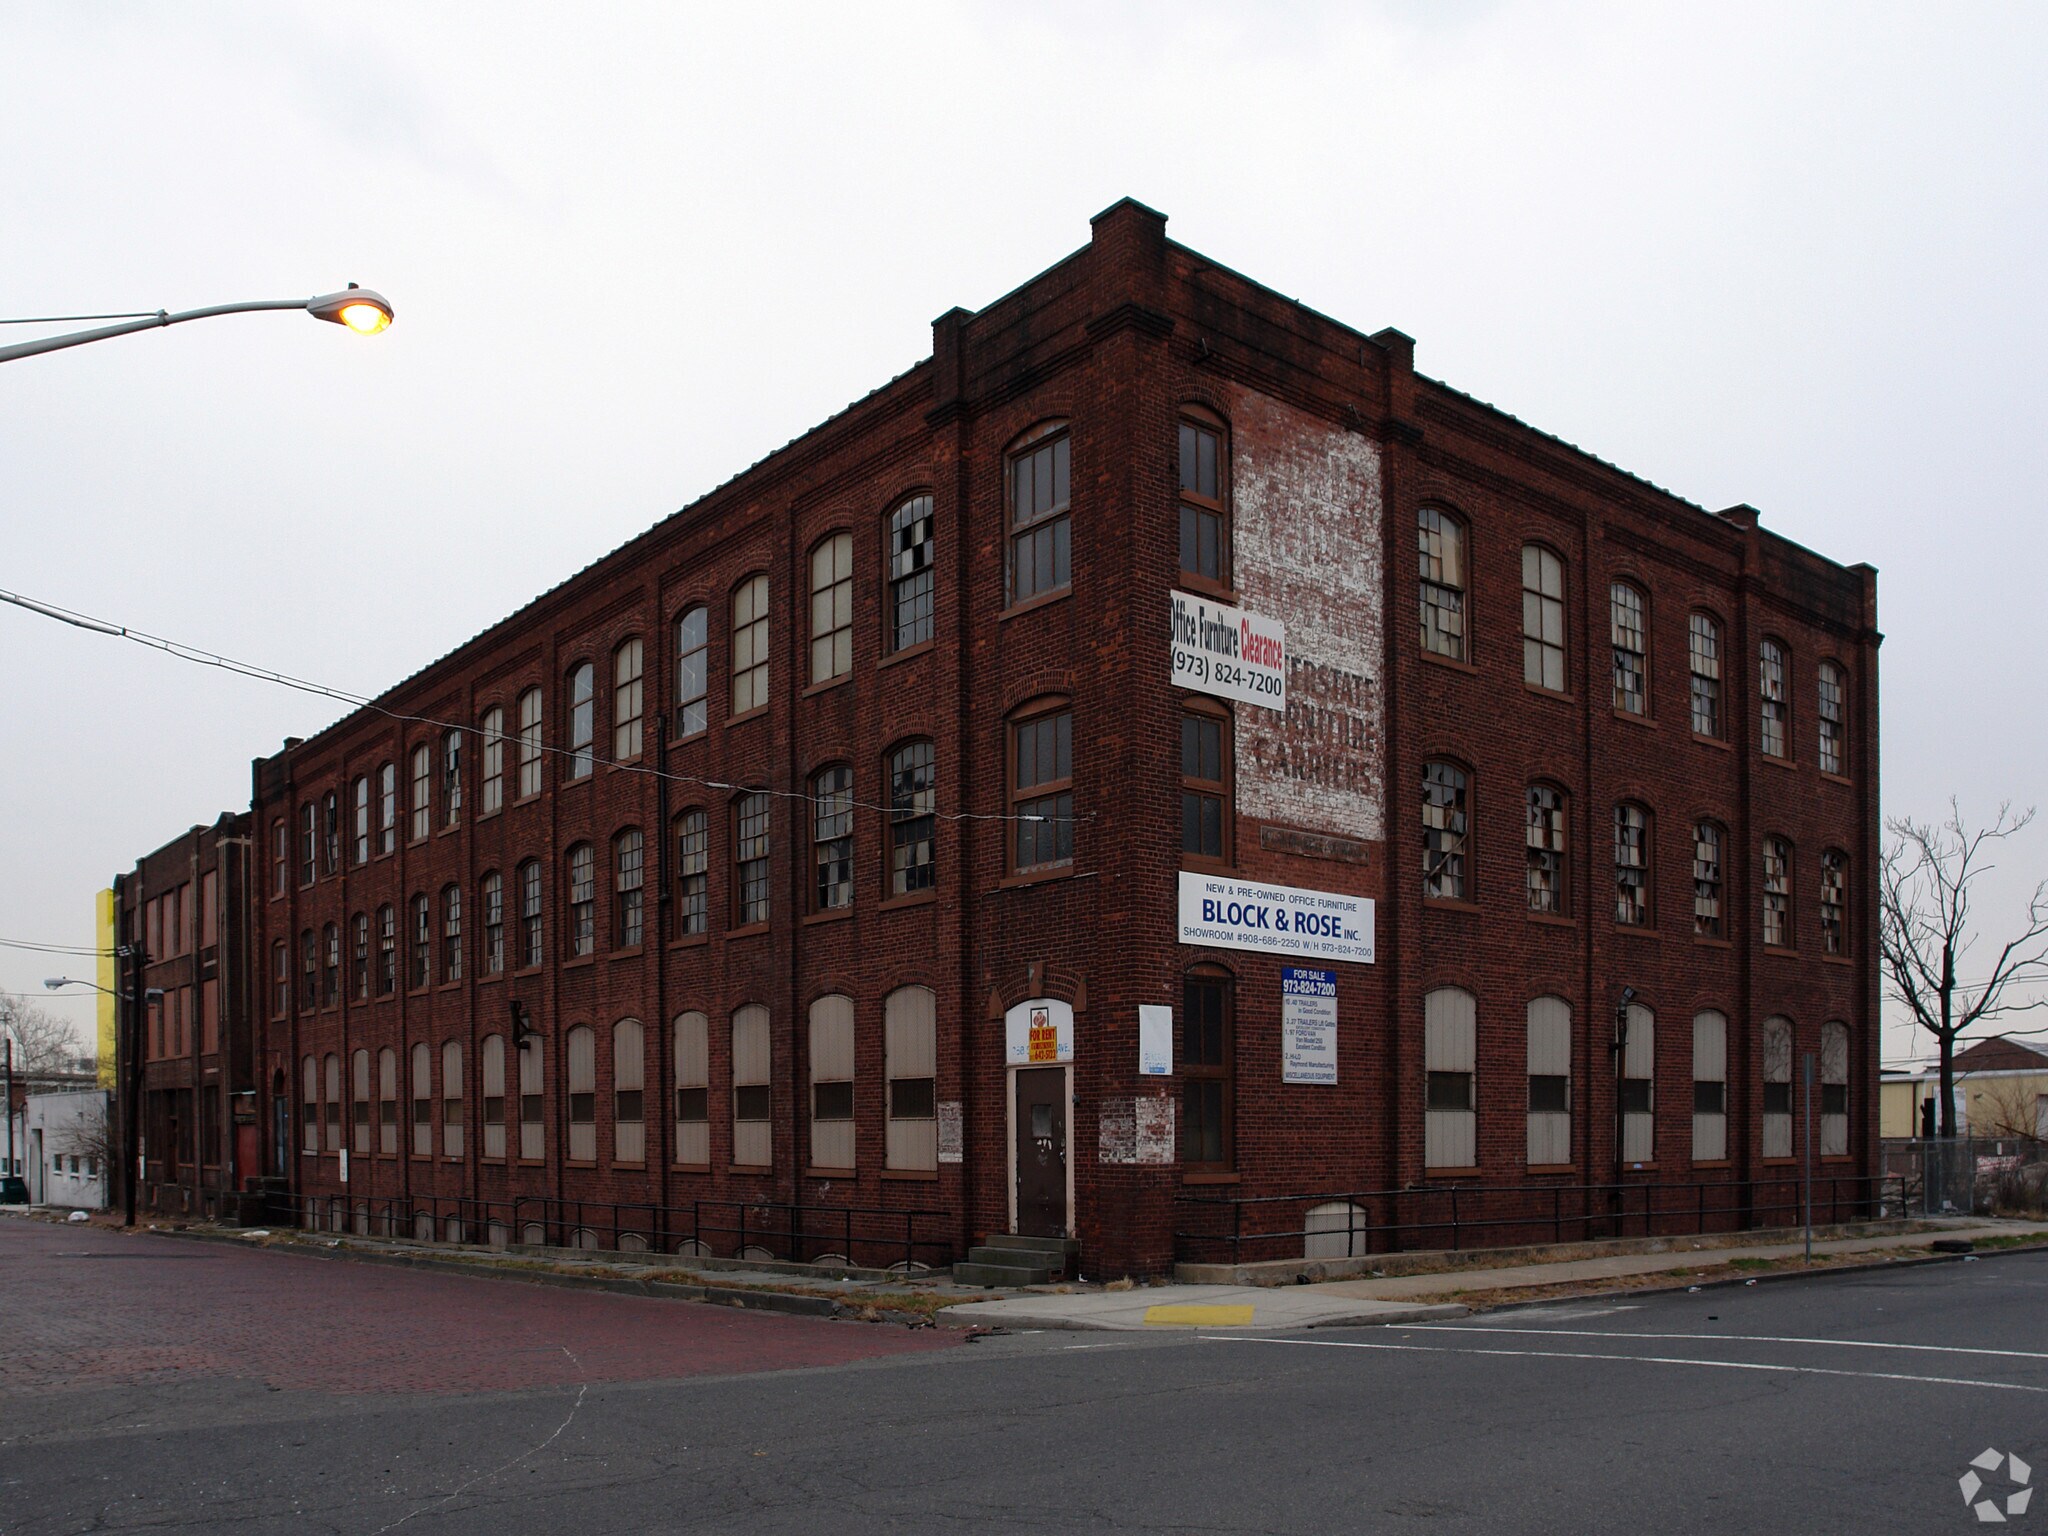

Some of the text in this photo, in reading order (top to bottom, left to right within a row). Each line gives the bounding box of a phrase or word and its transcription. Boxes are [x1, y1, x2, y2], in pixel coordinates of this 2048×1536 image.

[1199, 606, 1238, 659] Furniture
[1241, 617, 1283, 671] Clearance
[1171, 646, 1282, 696] (973) 824-7200
[1206, 883, 1357, 912] NEW & PRE-OWNED OFFICE FURNITURE
[1202, 899, 1361, 941] BLOCK & ROSE INC.
[1183, 926, 1372, 957] SHOWROOM #908-686-2250 W/H 973-824-7200
[1283, 979, 1336, 996] 973-824-7200
[1293, 969, 1326, 981] FOR SALE
[1030, 1028, 1055, 1041] FOR RENT
